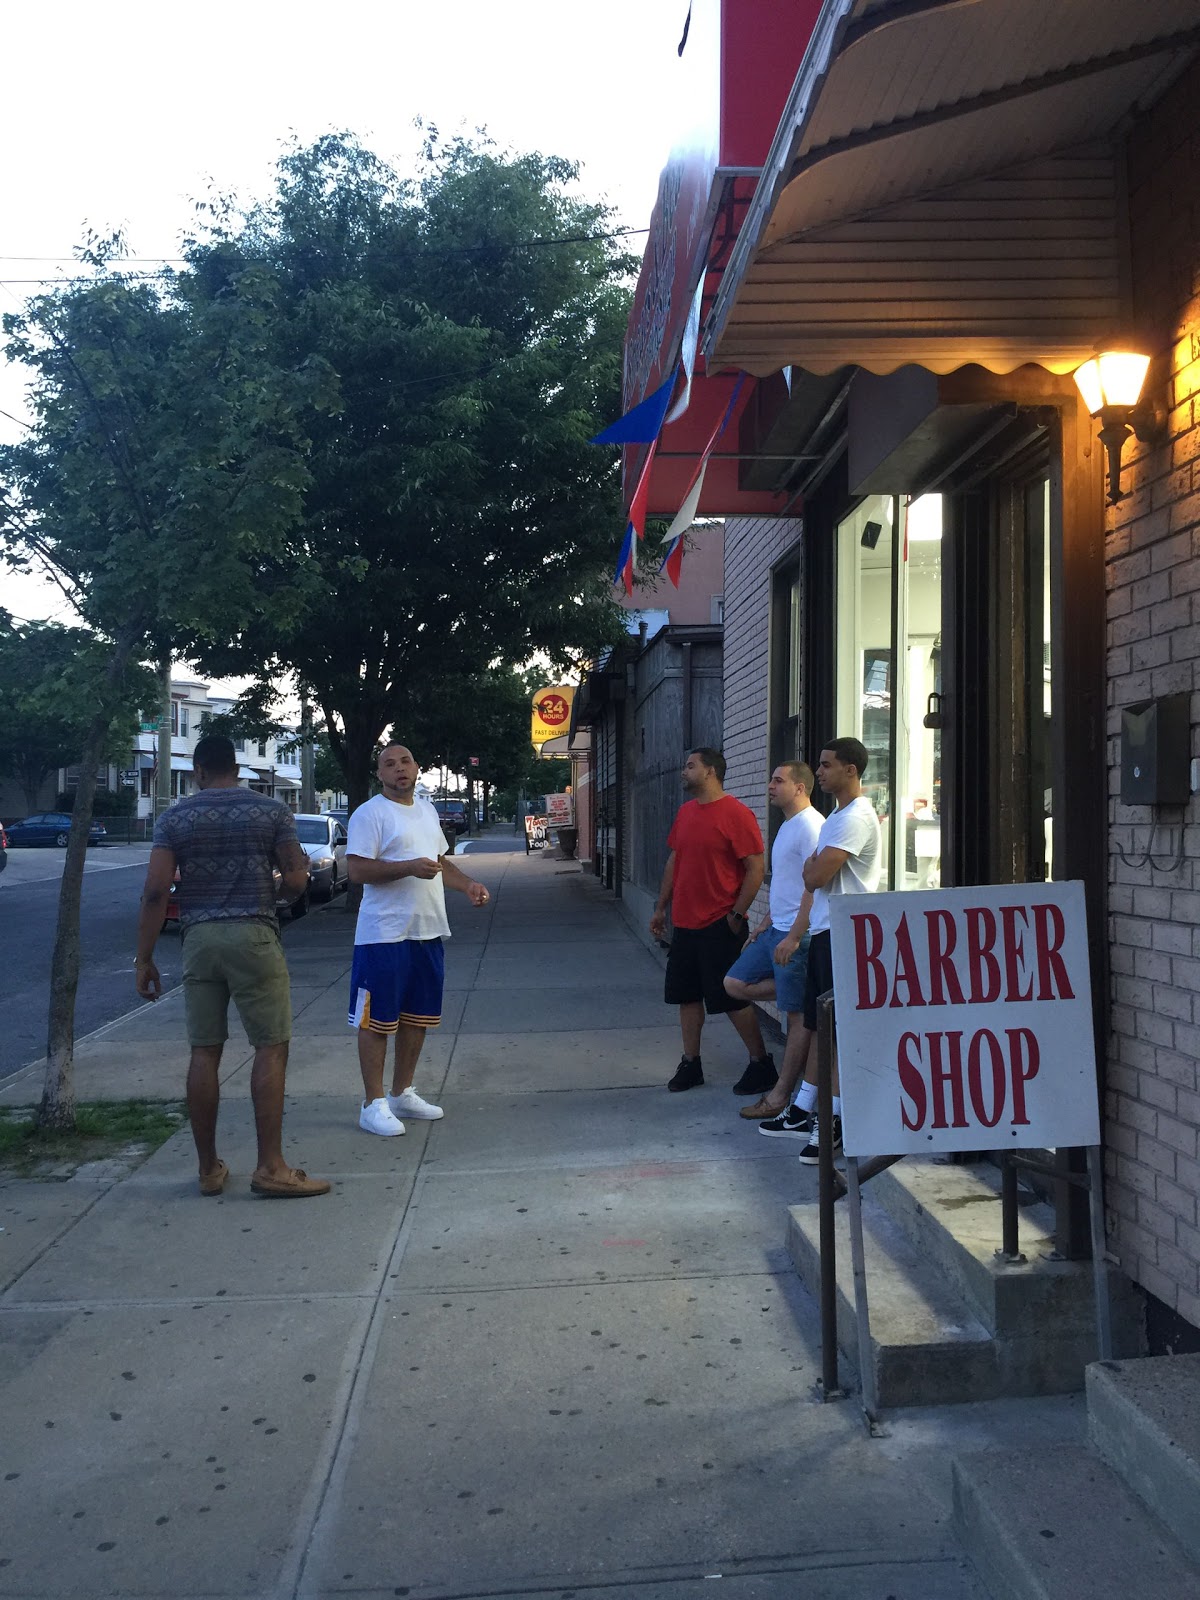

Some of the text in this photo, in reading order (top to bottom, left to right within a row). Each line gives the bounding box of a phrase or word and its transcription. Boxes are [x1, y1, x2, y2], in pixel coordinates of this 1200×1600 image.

[543, 700, 564, 714] 24
[525, 816, 533, 831] 7
[533, 826, 547, 839] HOT
[529, 839, 549, 849] FOOD
[850, 904, 1076, 1011] BARBER
[897, 1027, 1041, 1132] SHOP
